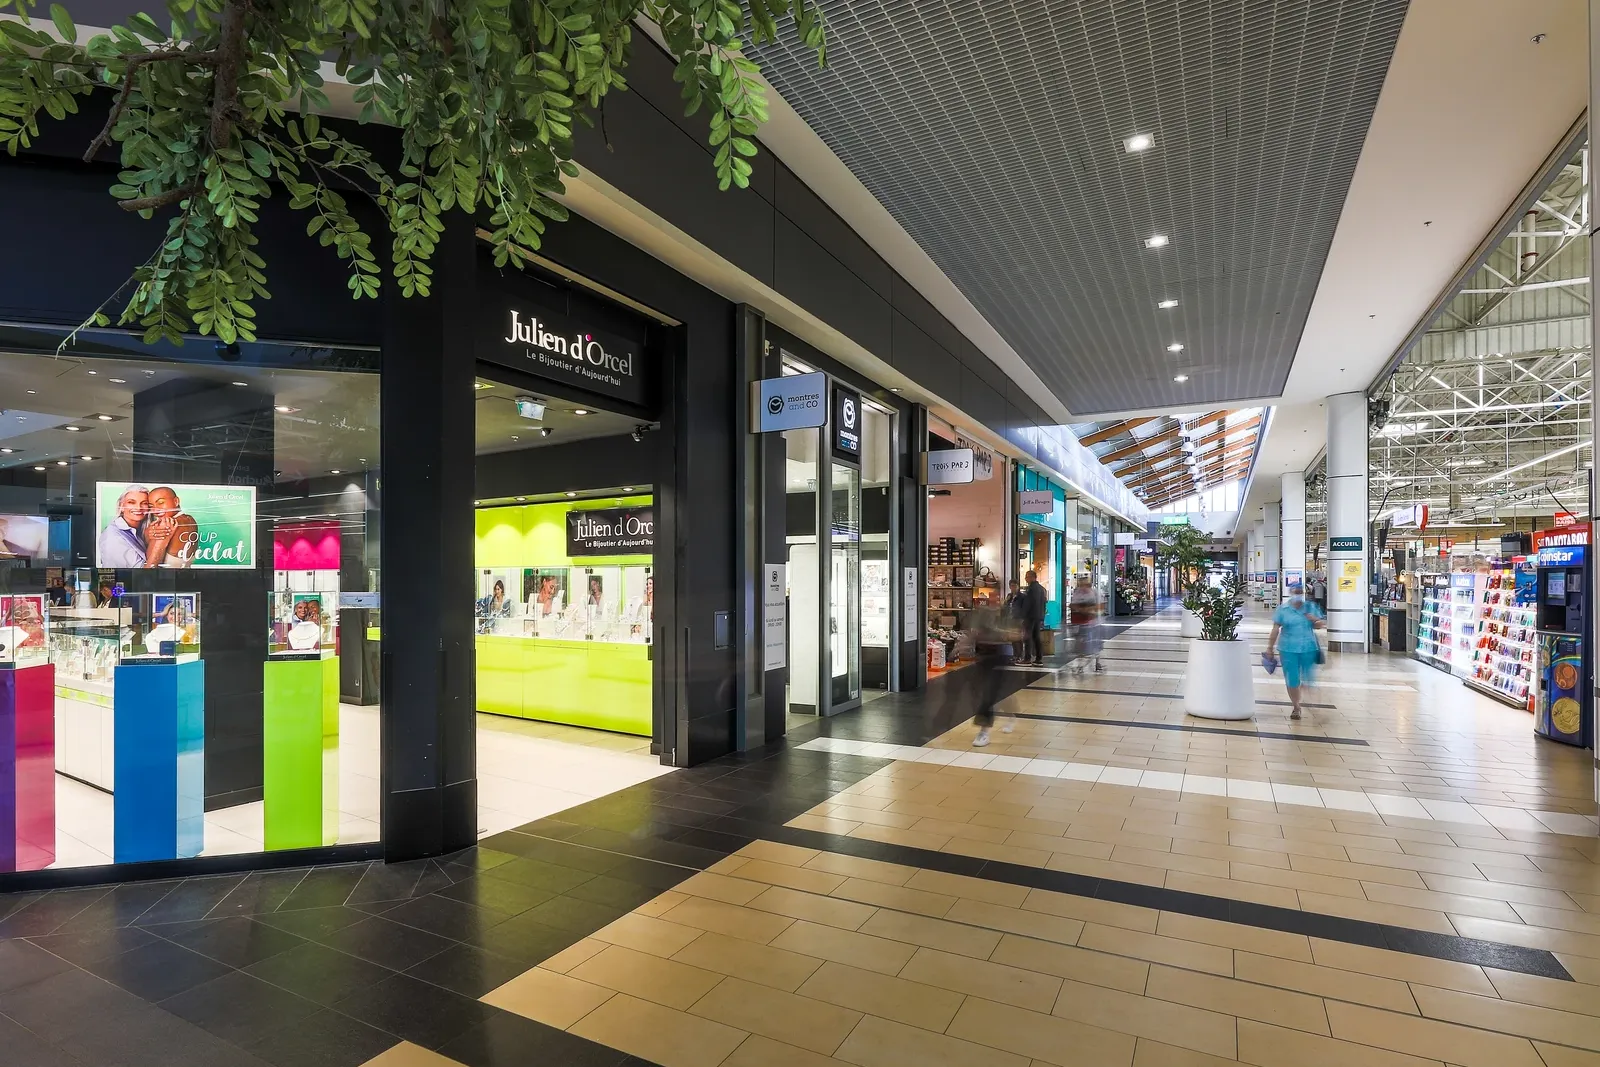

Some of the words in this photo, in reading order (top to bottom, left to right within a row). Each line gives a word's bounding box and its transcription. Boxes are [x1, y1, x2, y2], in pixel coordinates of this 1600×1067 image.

[505, 310, 567, 355] Julien
[570, 333, 633, 376] d'Orcel
[526, 348, 537, 360] Le
[538, 353, 573, 372] Bijoutier
[574, 365, 621, 387] d'Aujourd'hui
[787, 393, 820, 403] montres
[788, 402, 805, 411] and
[806, 400, 818, 408] CO
[840, 430, 858, 442] montres
[850, 441, 857, 450] CO
[951, 461, 964, 469] PAR
[574, 518, 611, 541] Julien
[179, 532, 218, 542] COUP
[593, 540, 616, 548] Bijoutier
[177, 540, 247, 562] d'éclat
